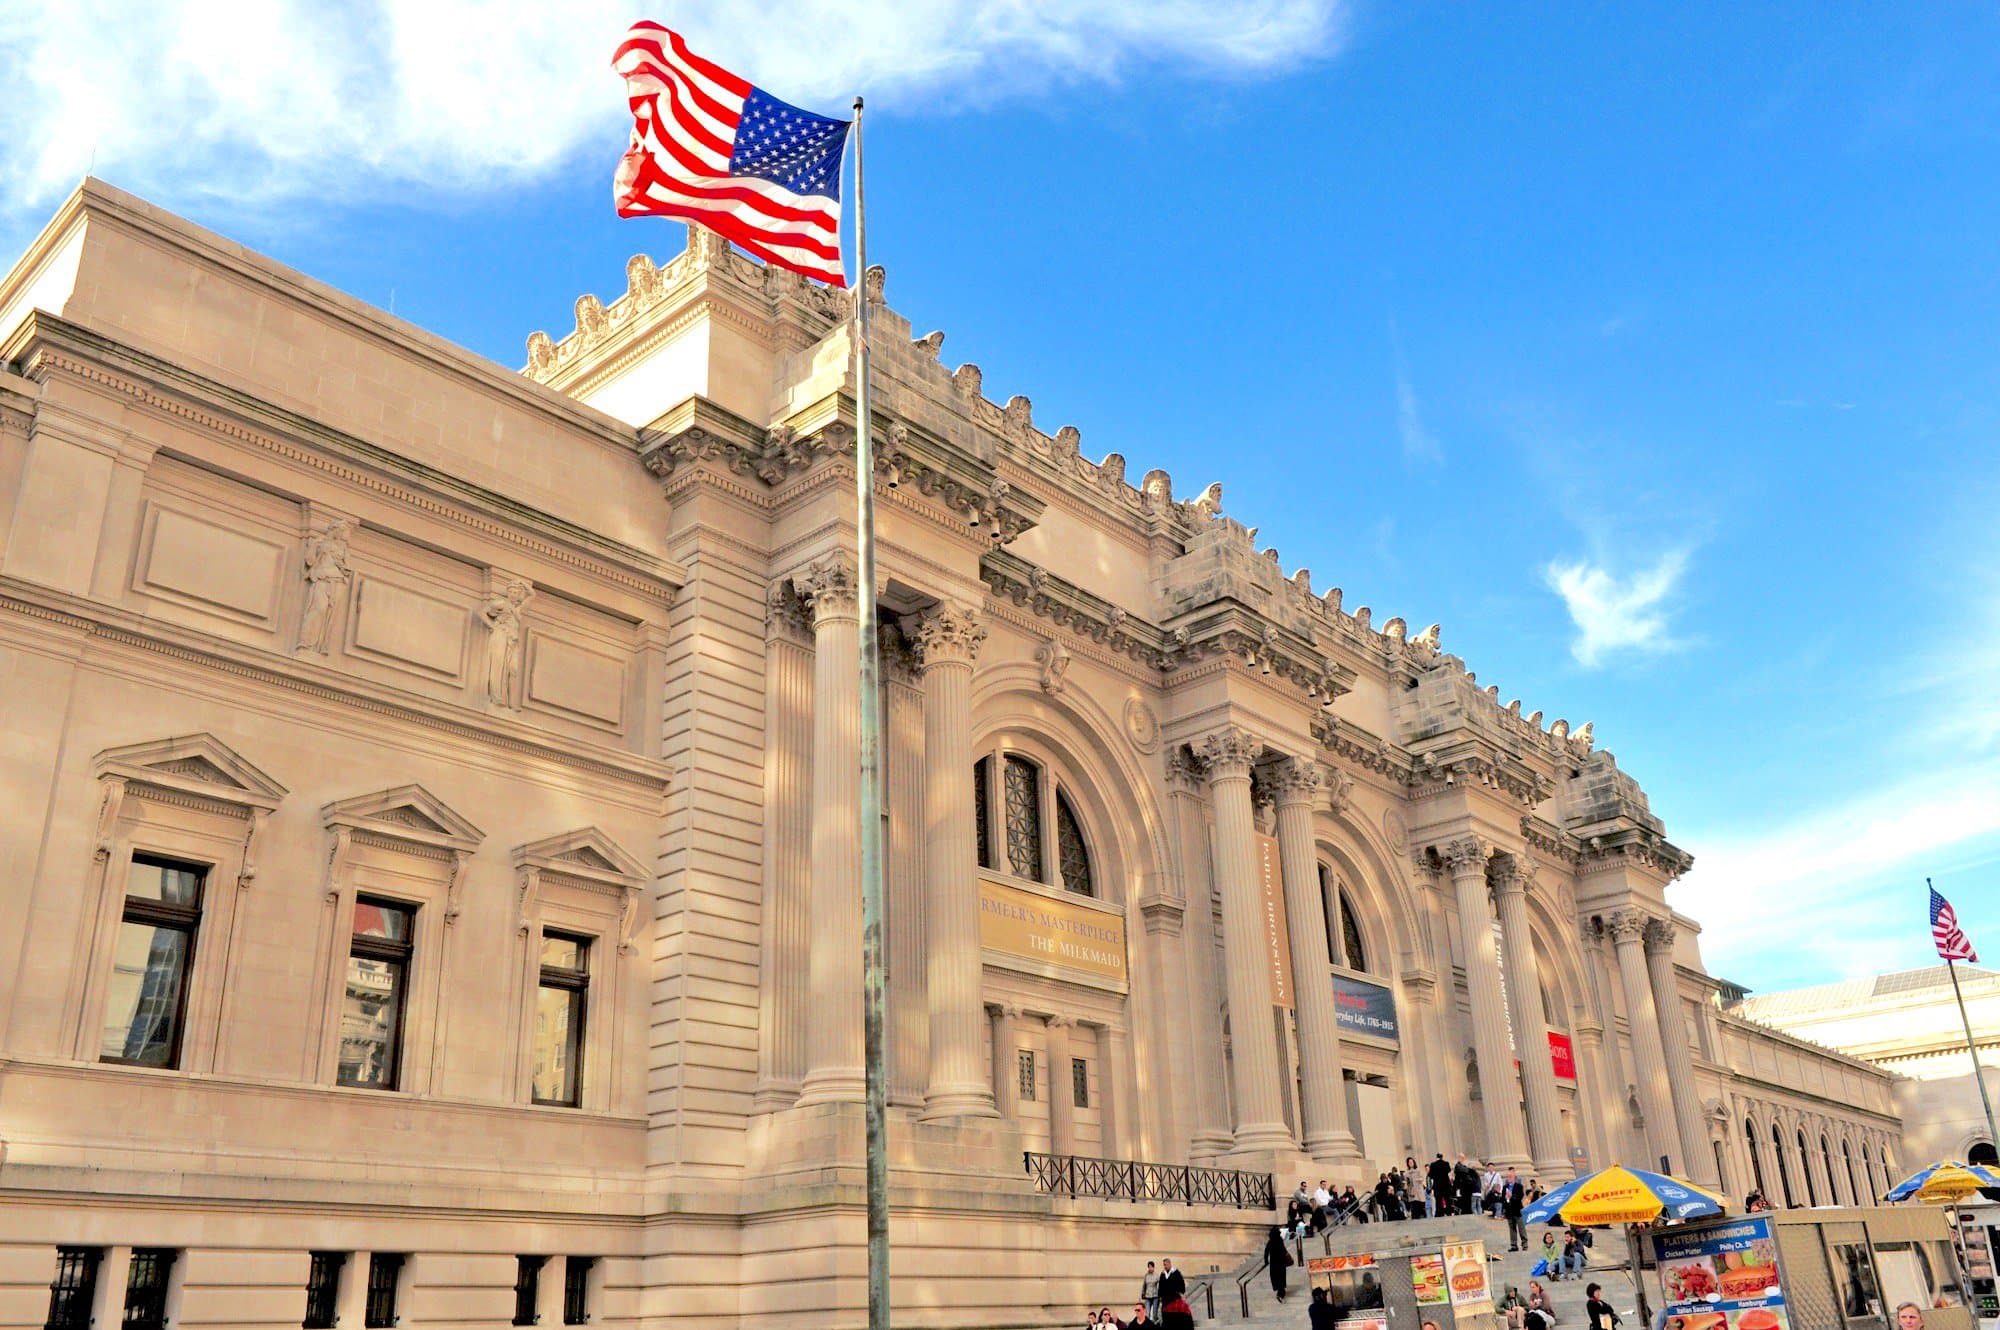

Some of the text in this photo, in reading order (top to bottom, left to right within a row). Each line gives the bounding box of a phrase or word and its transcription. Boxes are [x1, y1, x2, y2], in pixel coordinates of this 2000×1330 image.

[981, 897, 1119, 944] RMEER'S MASTERPIECE
[1028, 933, 1121, 968] THE MILKMAID
[1495, 944, 1503, 970] THE
[1583, 1188, 1640, 1202] SABRETT
[1569, 1207, 1655, 1222] FRANKFURTERS & ROLLS
[1663, 1225, 1756, 1247] PLATTERS & SANDWICHES
[1456, 1291, 1470, 1301] HOT
[1737, 1299, 1768, 1308] Hamburger
